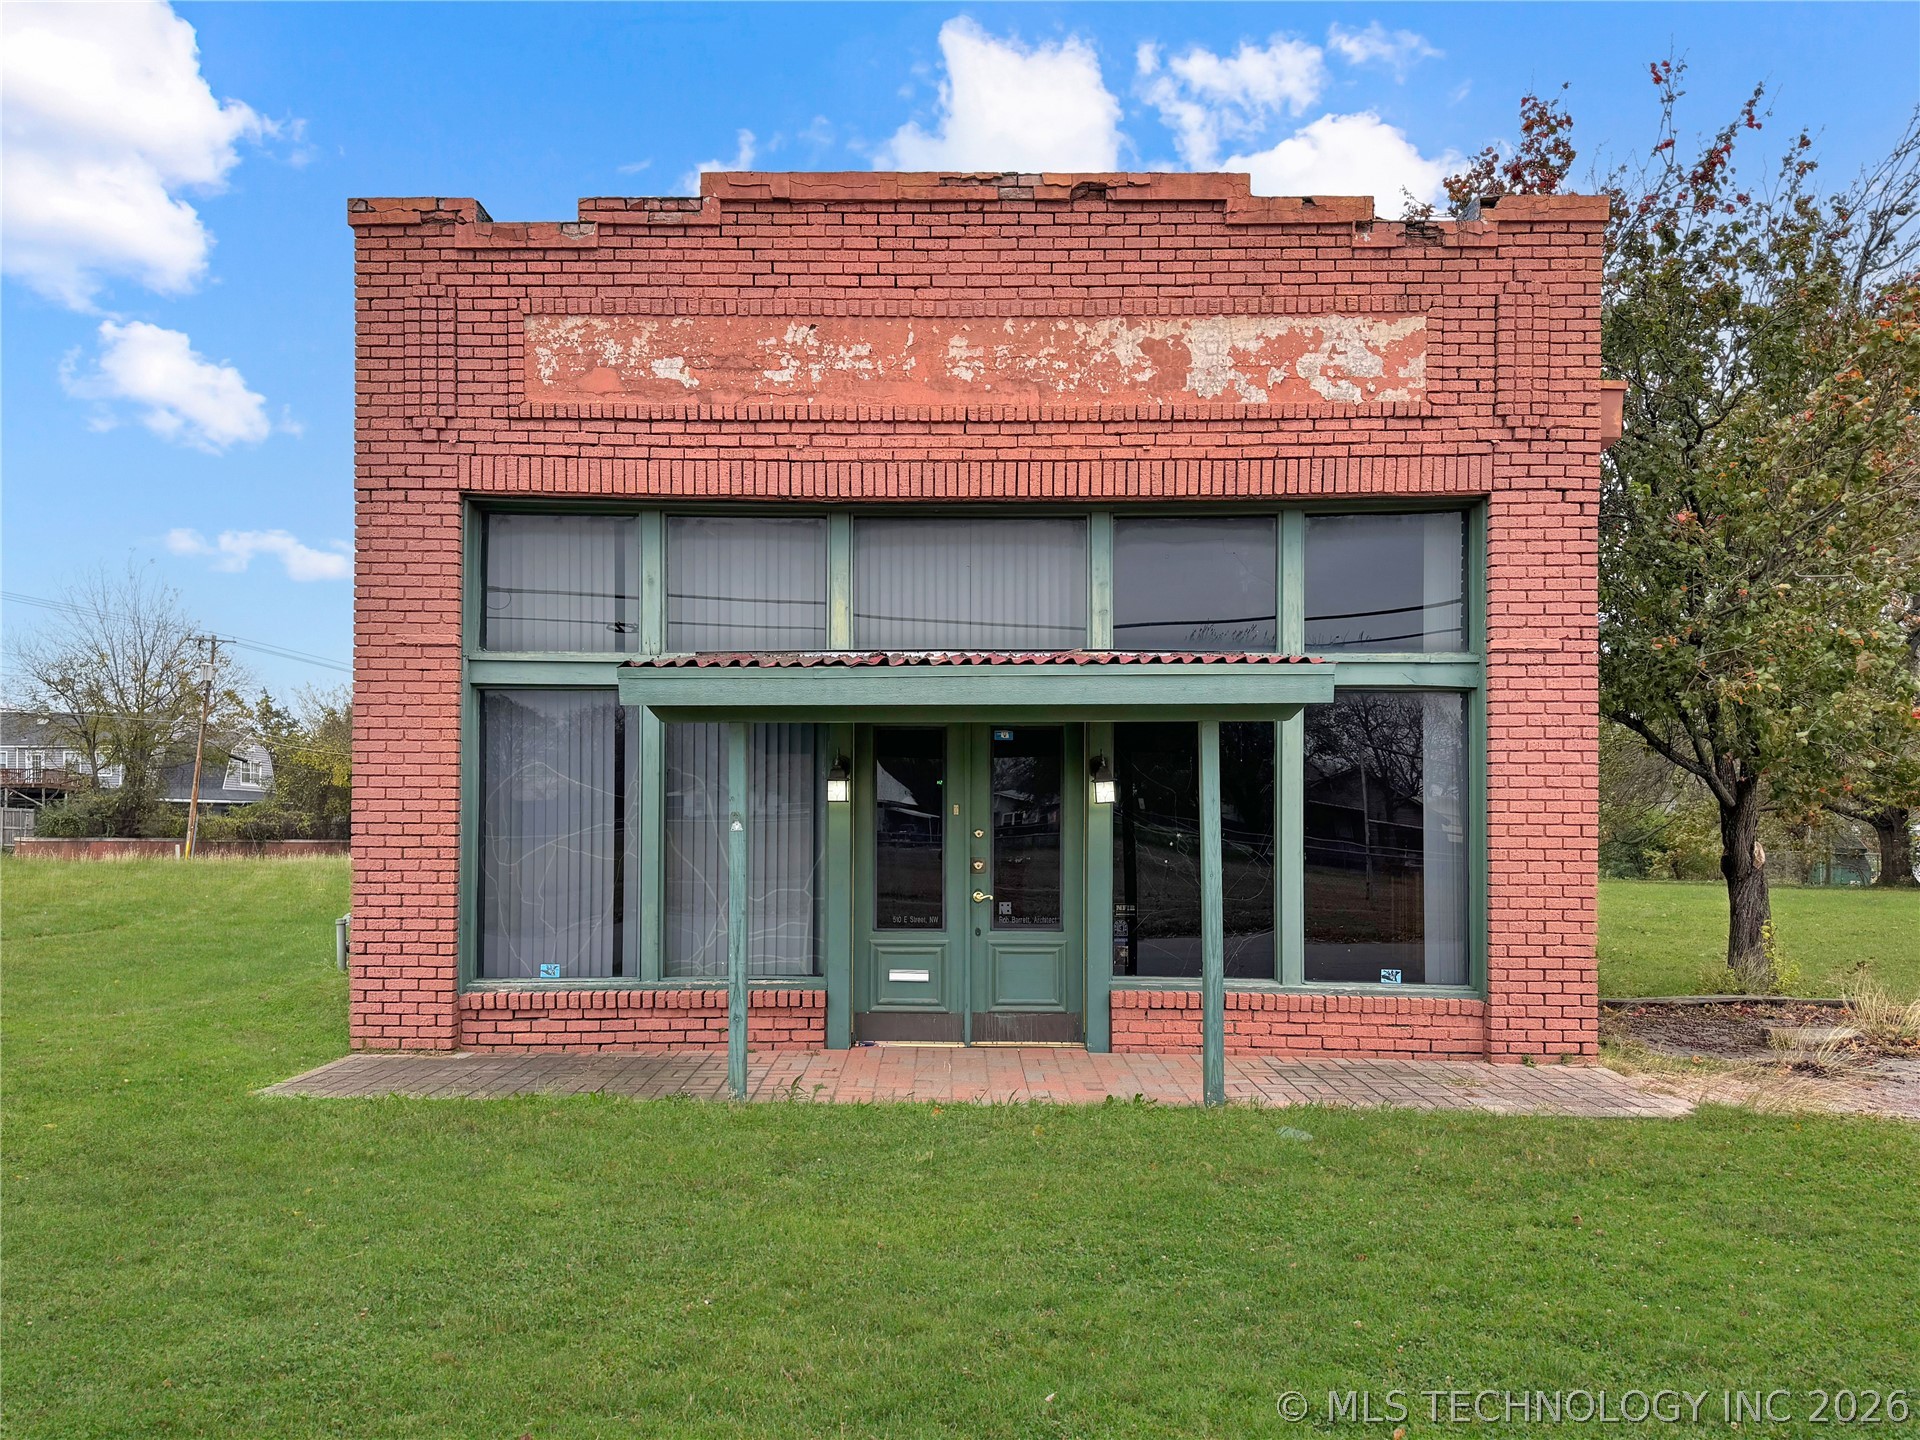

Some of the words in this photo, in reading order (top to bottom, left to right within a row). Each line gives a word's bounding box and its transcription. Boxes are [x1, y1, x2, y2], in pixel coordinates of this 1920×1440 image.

[903, 915, 908, 923] E
[929, 915, 939, 923] NW
[998, 916, 1010, 924] Rob
[1033, 916, 1057, 924] Architect
